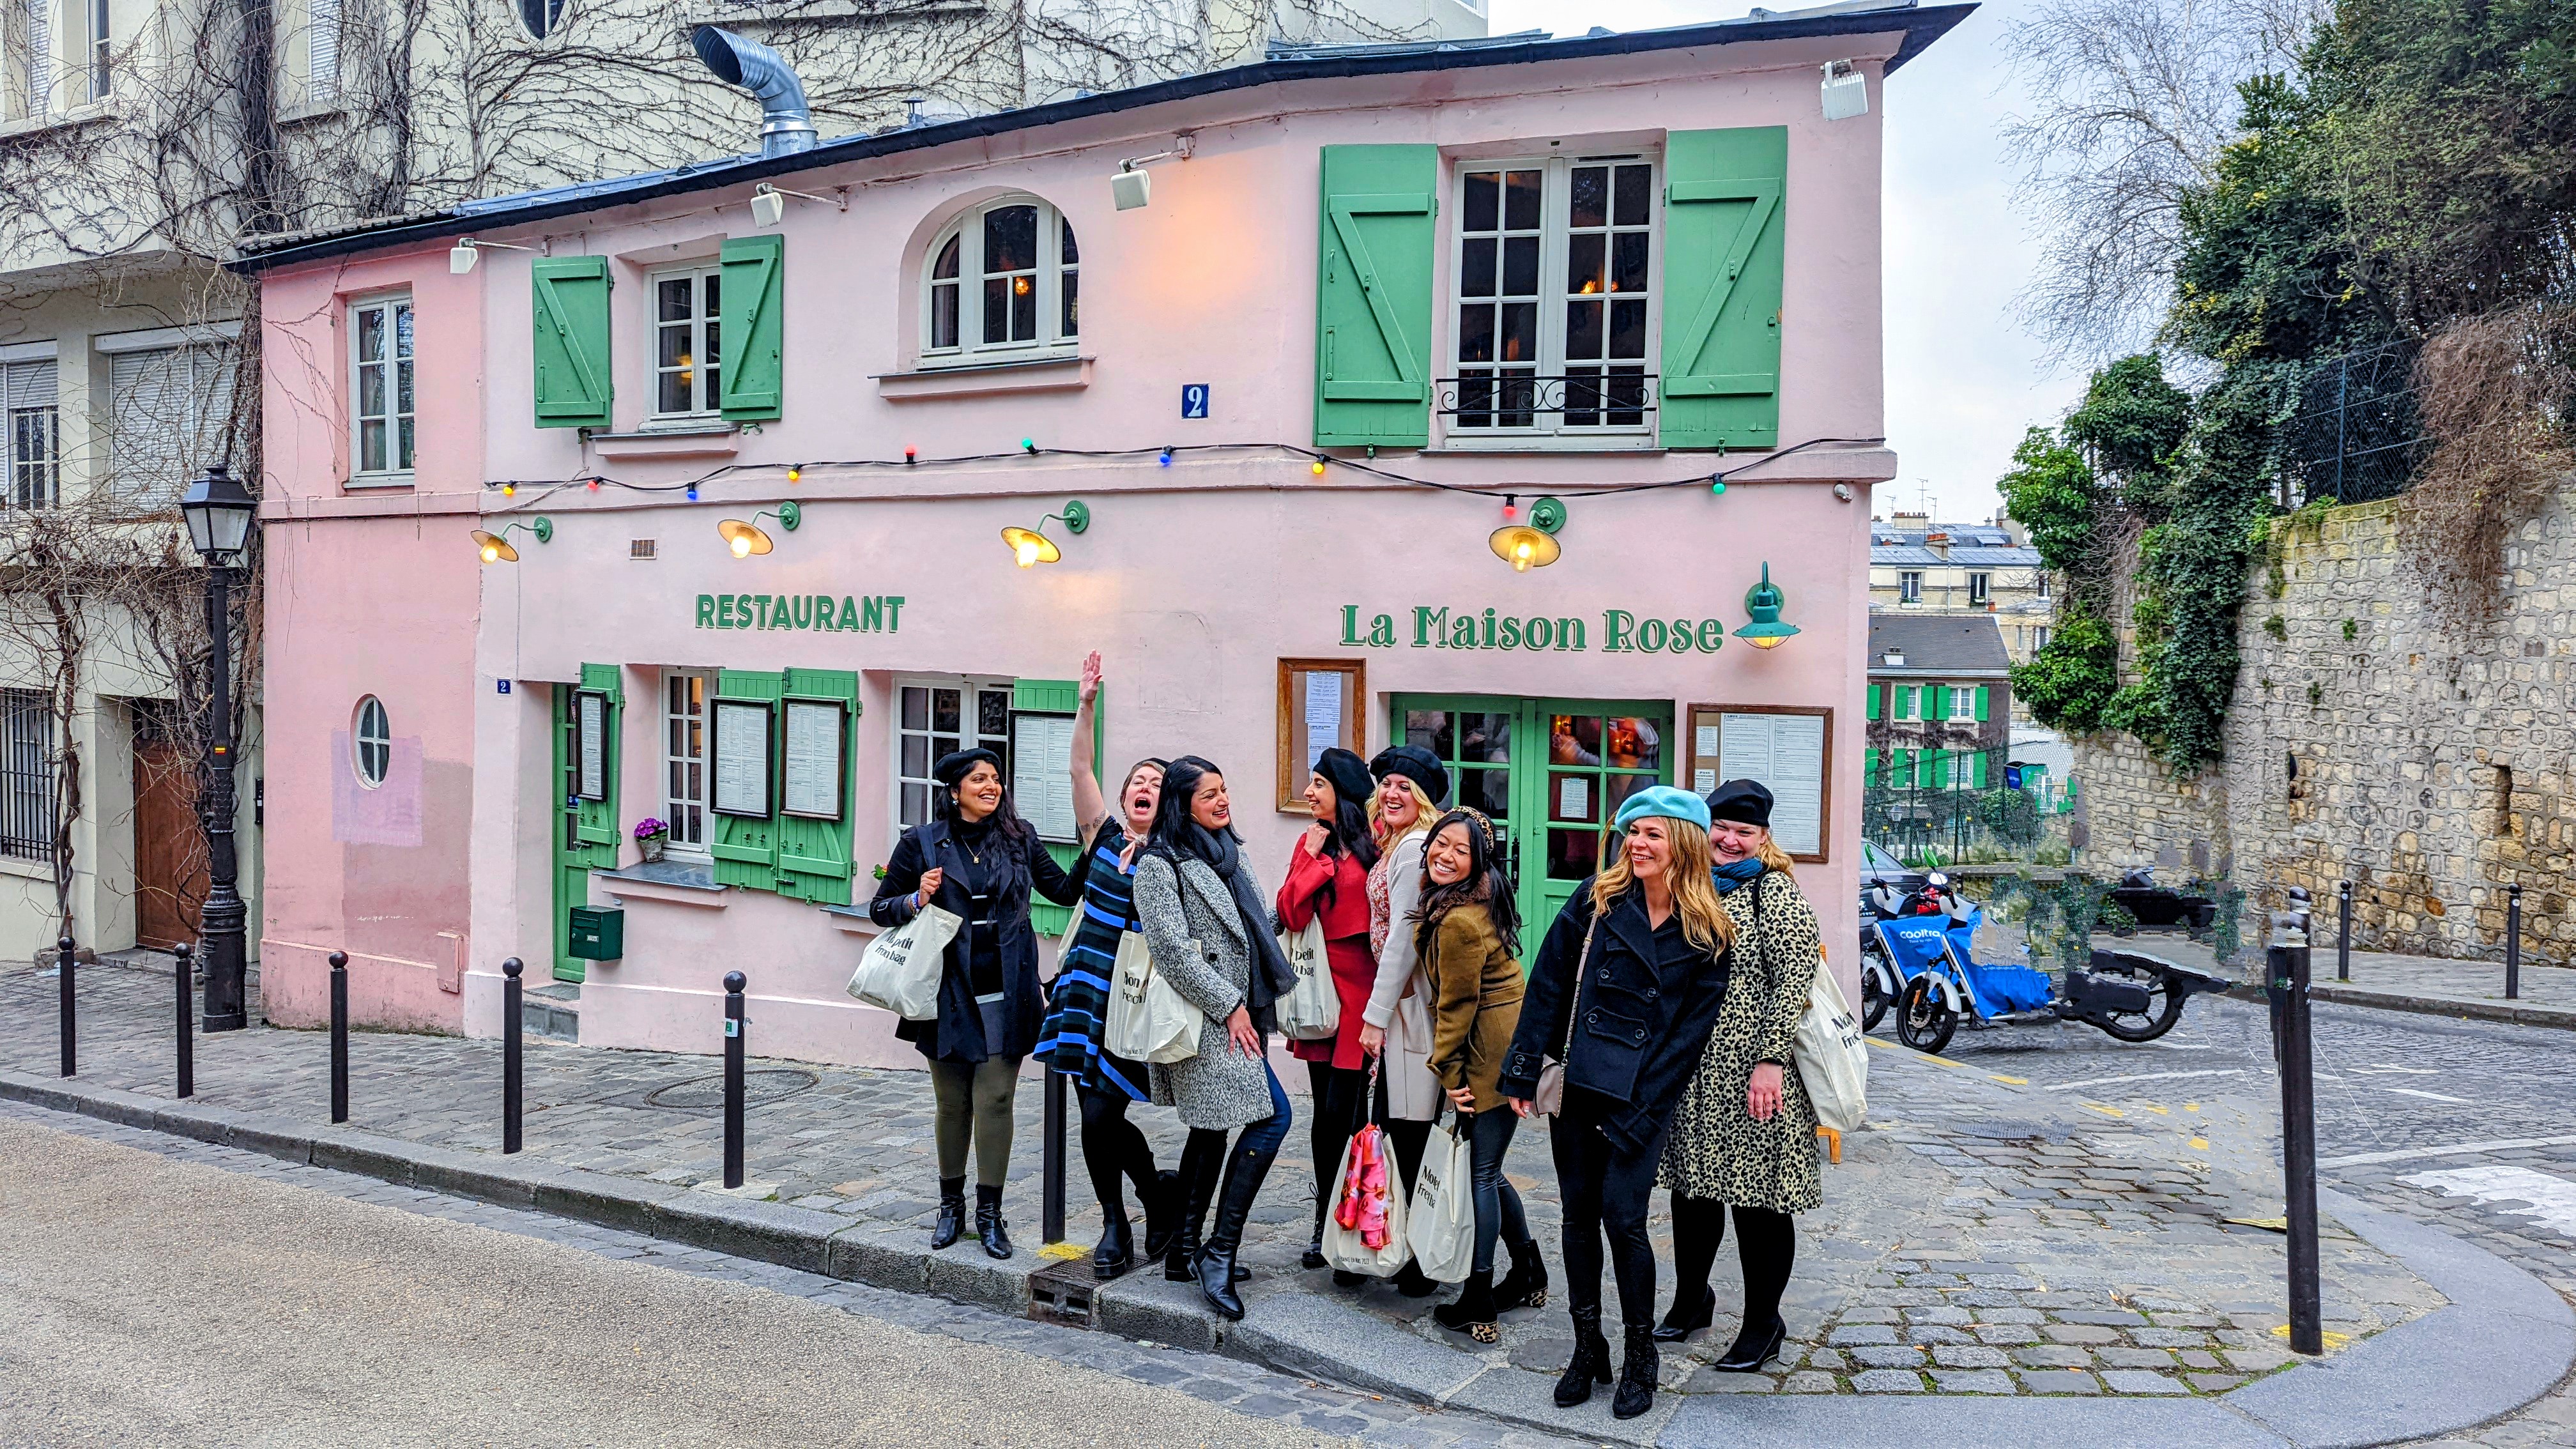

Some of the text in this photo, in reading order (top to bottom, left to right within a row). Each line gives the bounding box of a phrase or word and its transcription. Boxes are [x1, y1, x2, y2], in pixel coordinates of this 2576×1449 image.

[1188, 387, 1202, 417] 2
[695, 594, 905, 634] RESTAURANT
[1339, 604, 1724, 654] La Maison Rose
[500, 681, 507, 693] 2
[1899, 929, 1941, 939] cooltra
[889, 950, 907, 966] bag
[1300, 965, 1314, 978] bag
